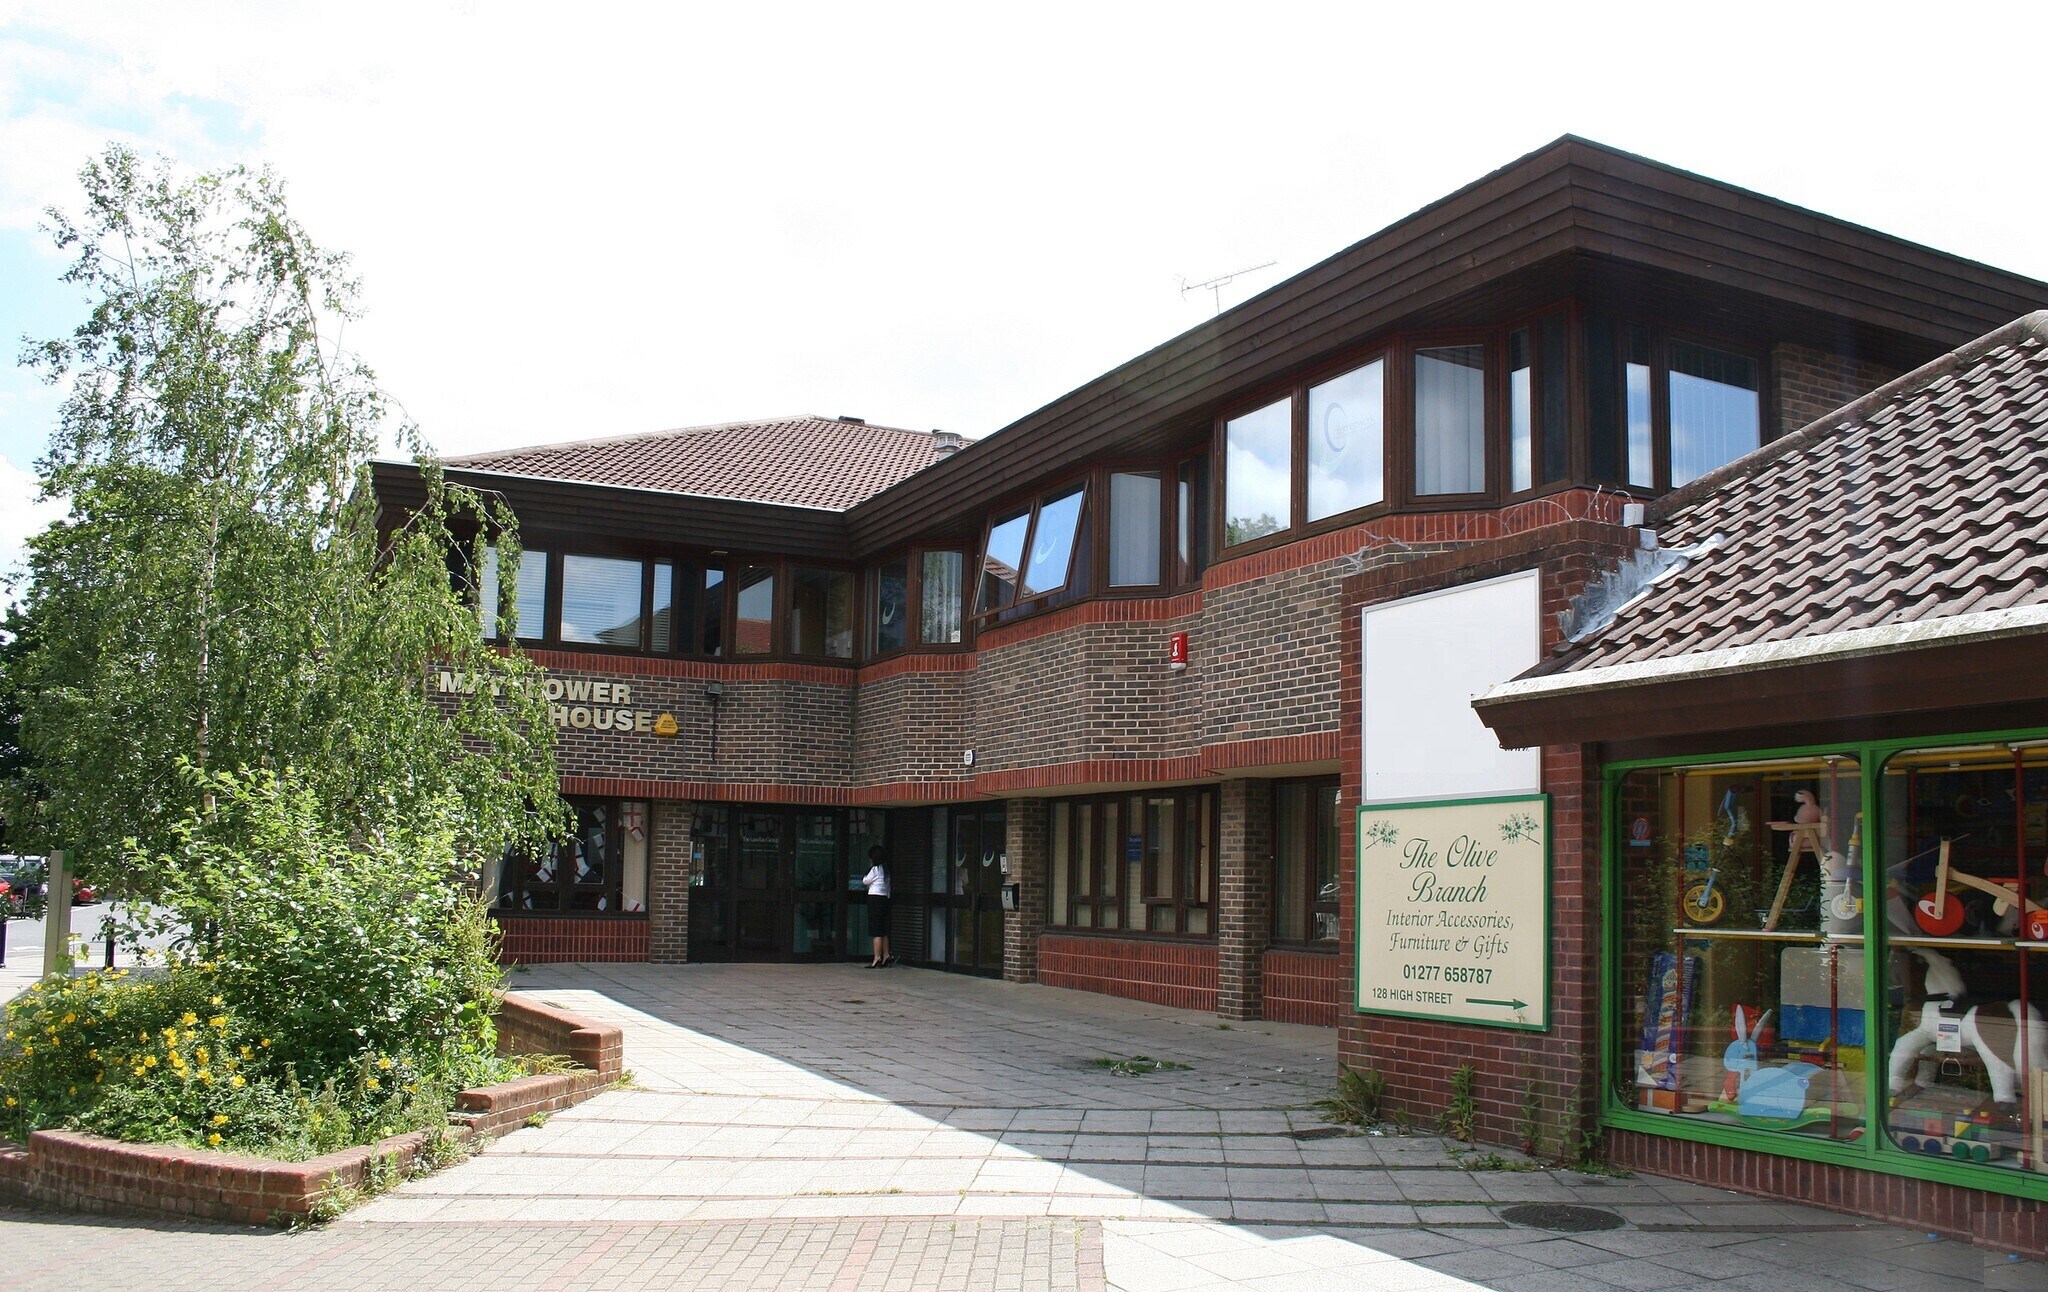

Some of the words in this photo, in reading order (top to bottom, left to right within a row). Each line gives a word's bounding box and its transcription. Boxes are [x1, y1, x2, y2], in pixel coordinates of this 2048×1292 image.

[440, 672, 631, 704] MYLOWER
[548, 706, 652, 732] HOUSE
[1399, 837, 1438, 869] The
[1446, 834, 1498, 867] Olive
[1407, 870, 1488, 902] Branch
[1386, 909, 1434, 927] Interior
[1435, 910, 1514, 931] Accessories,
[1389, 932, 1451, 952] Furniture
[1455, 935, 1469, 952] &
[1473, 932, 1509, 960] Gifts
[1403, 964, 1441, 981] 01277
[1444, 966, 1493, 984] 658787
[1372, 987, 1388, 999] 128
[1389, 989, 1414, 1001] HIGH
[1415, 991, 1453, 1005] STREET
